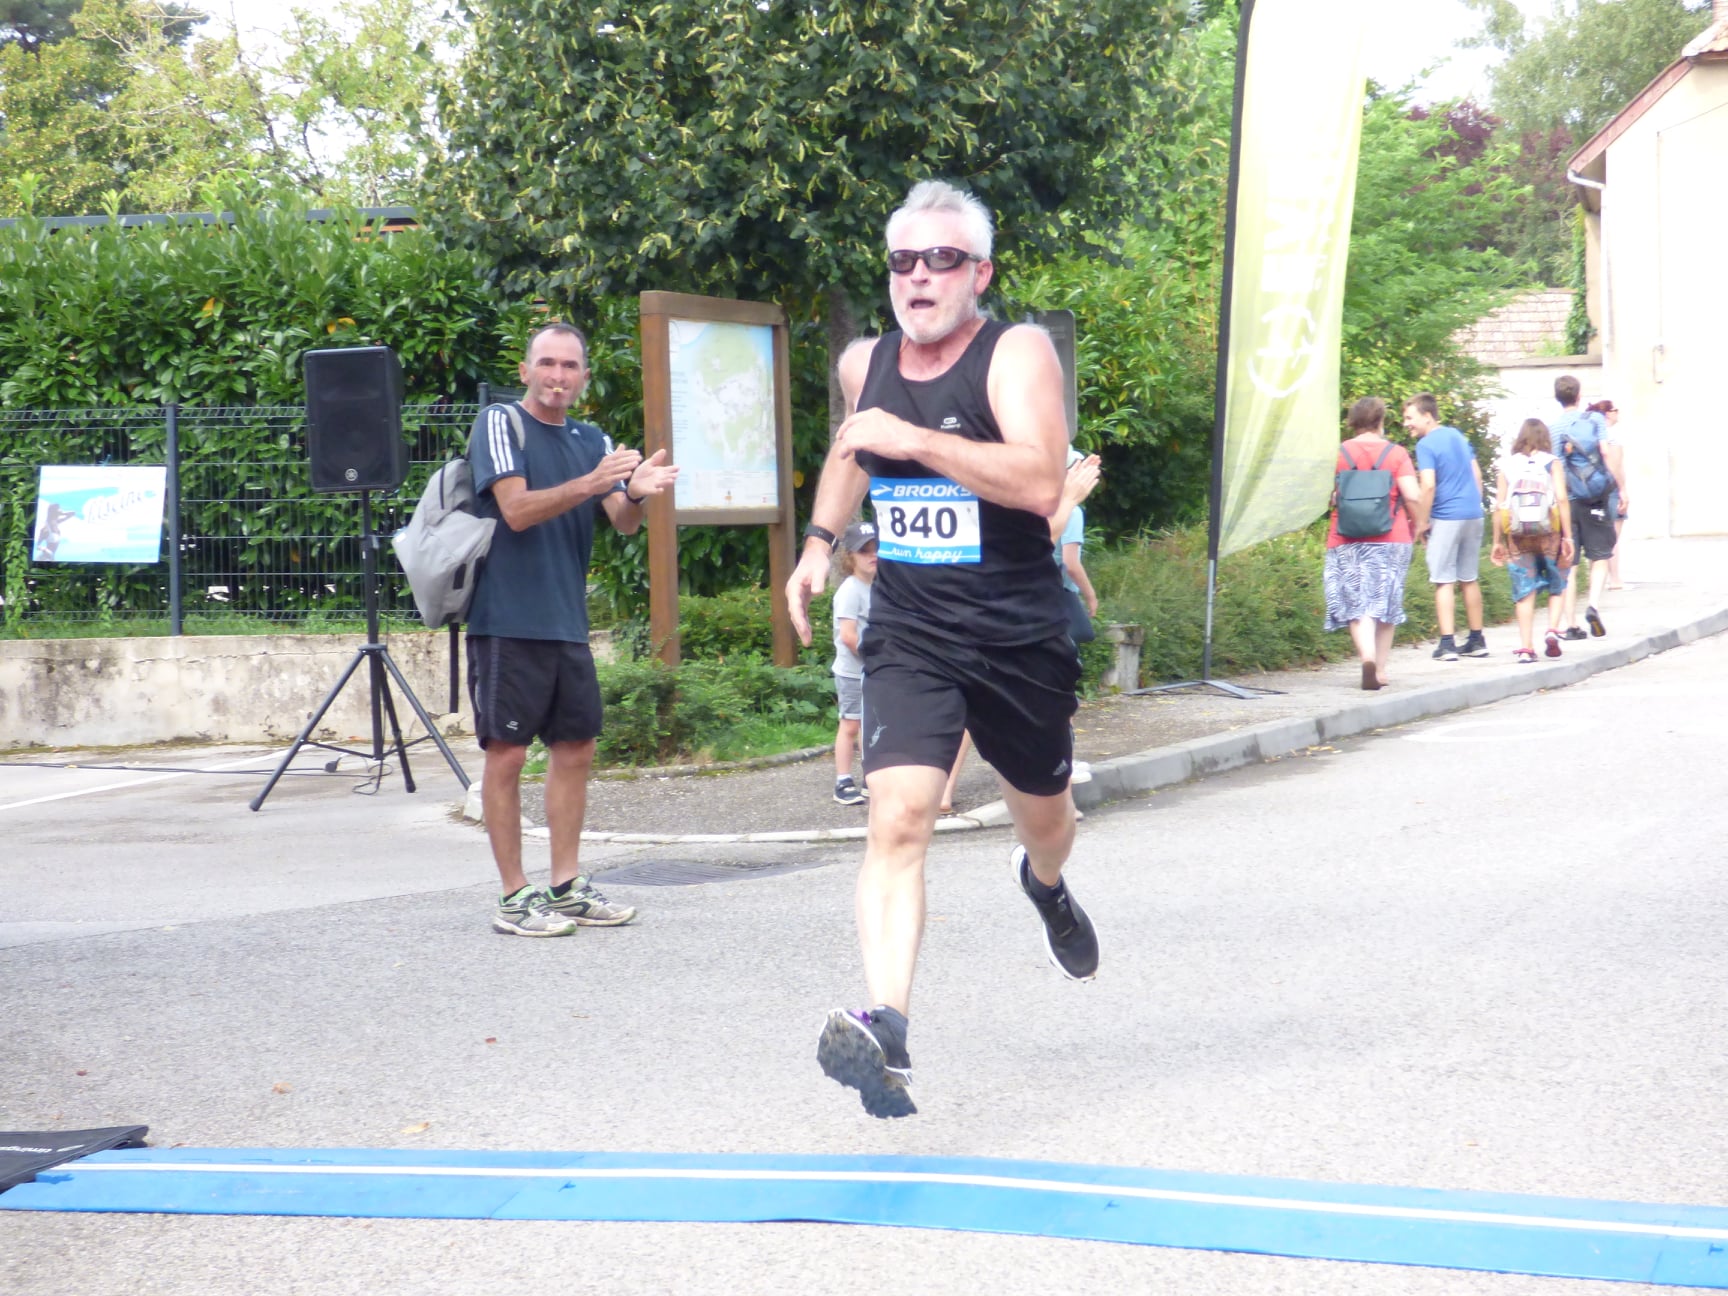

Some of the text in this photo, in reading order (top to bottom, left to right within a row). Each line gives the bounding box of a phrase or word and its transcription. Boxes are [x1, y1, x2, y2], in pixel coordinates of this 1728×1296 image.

[893, 484, 972, 497] BROOKS
[890, 506, 958, 539] 840
[914, 547, 964, 562] happy
